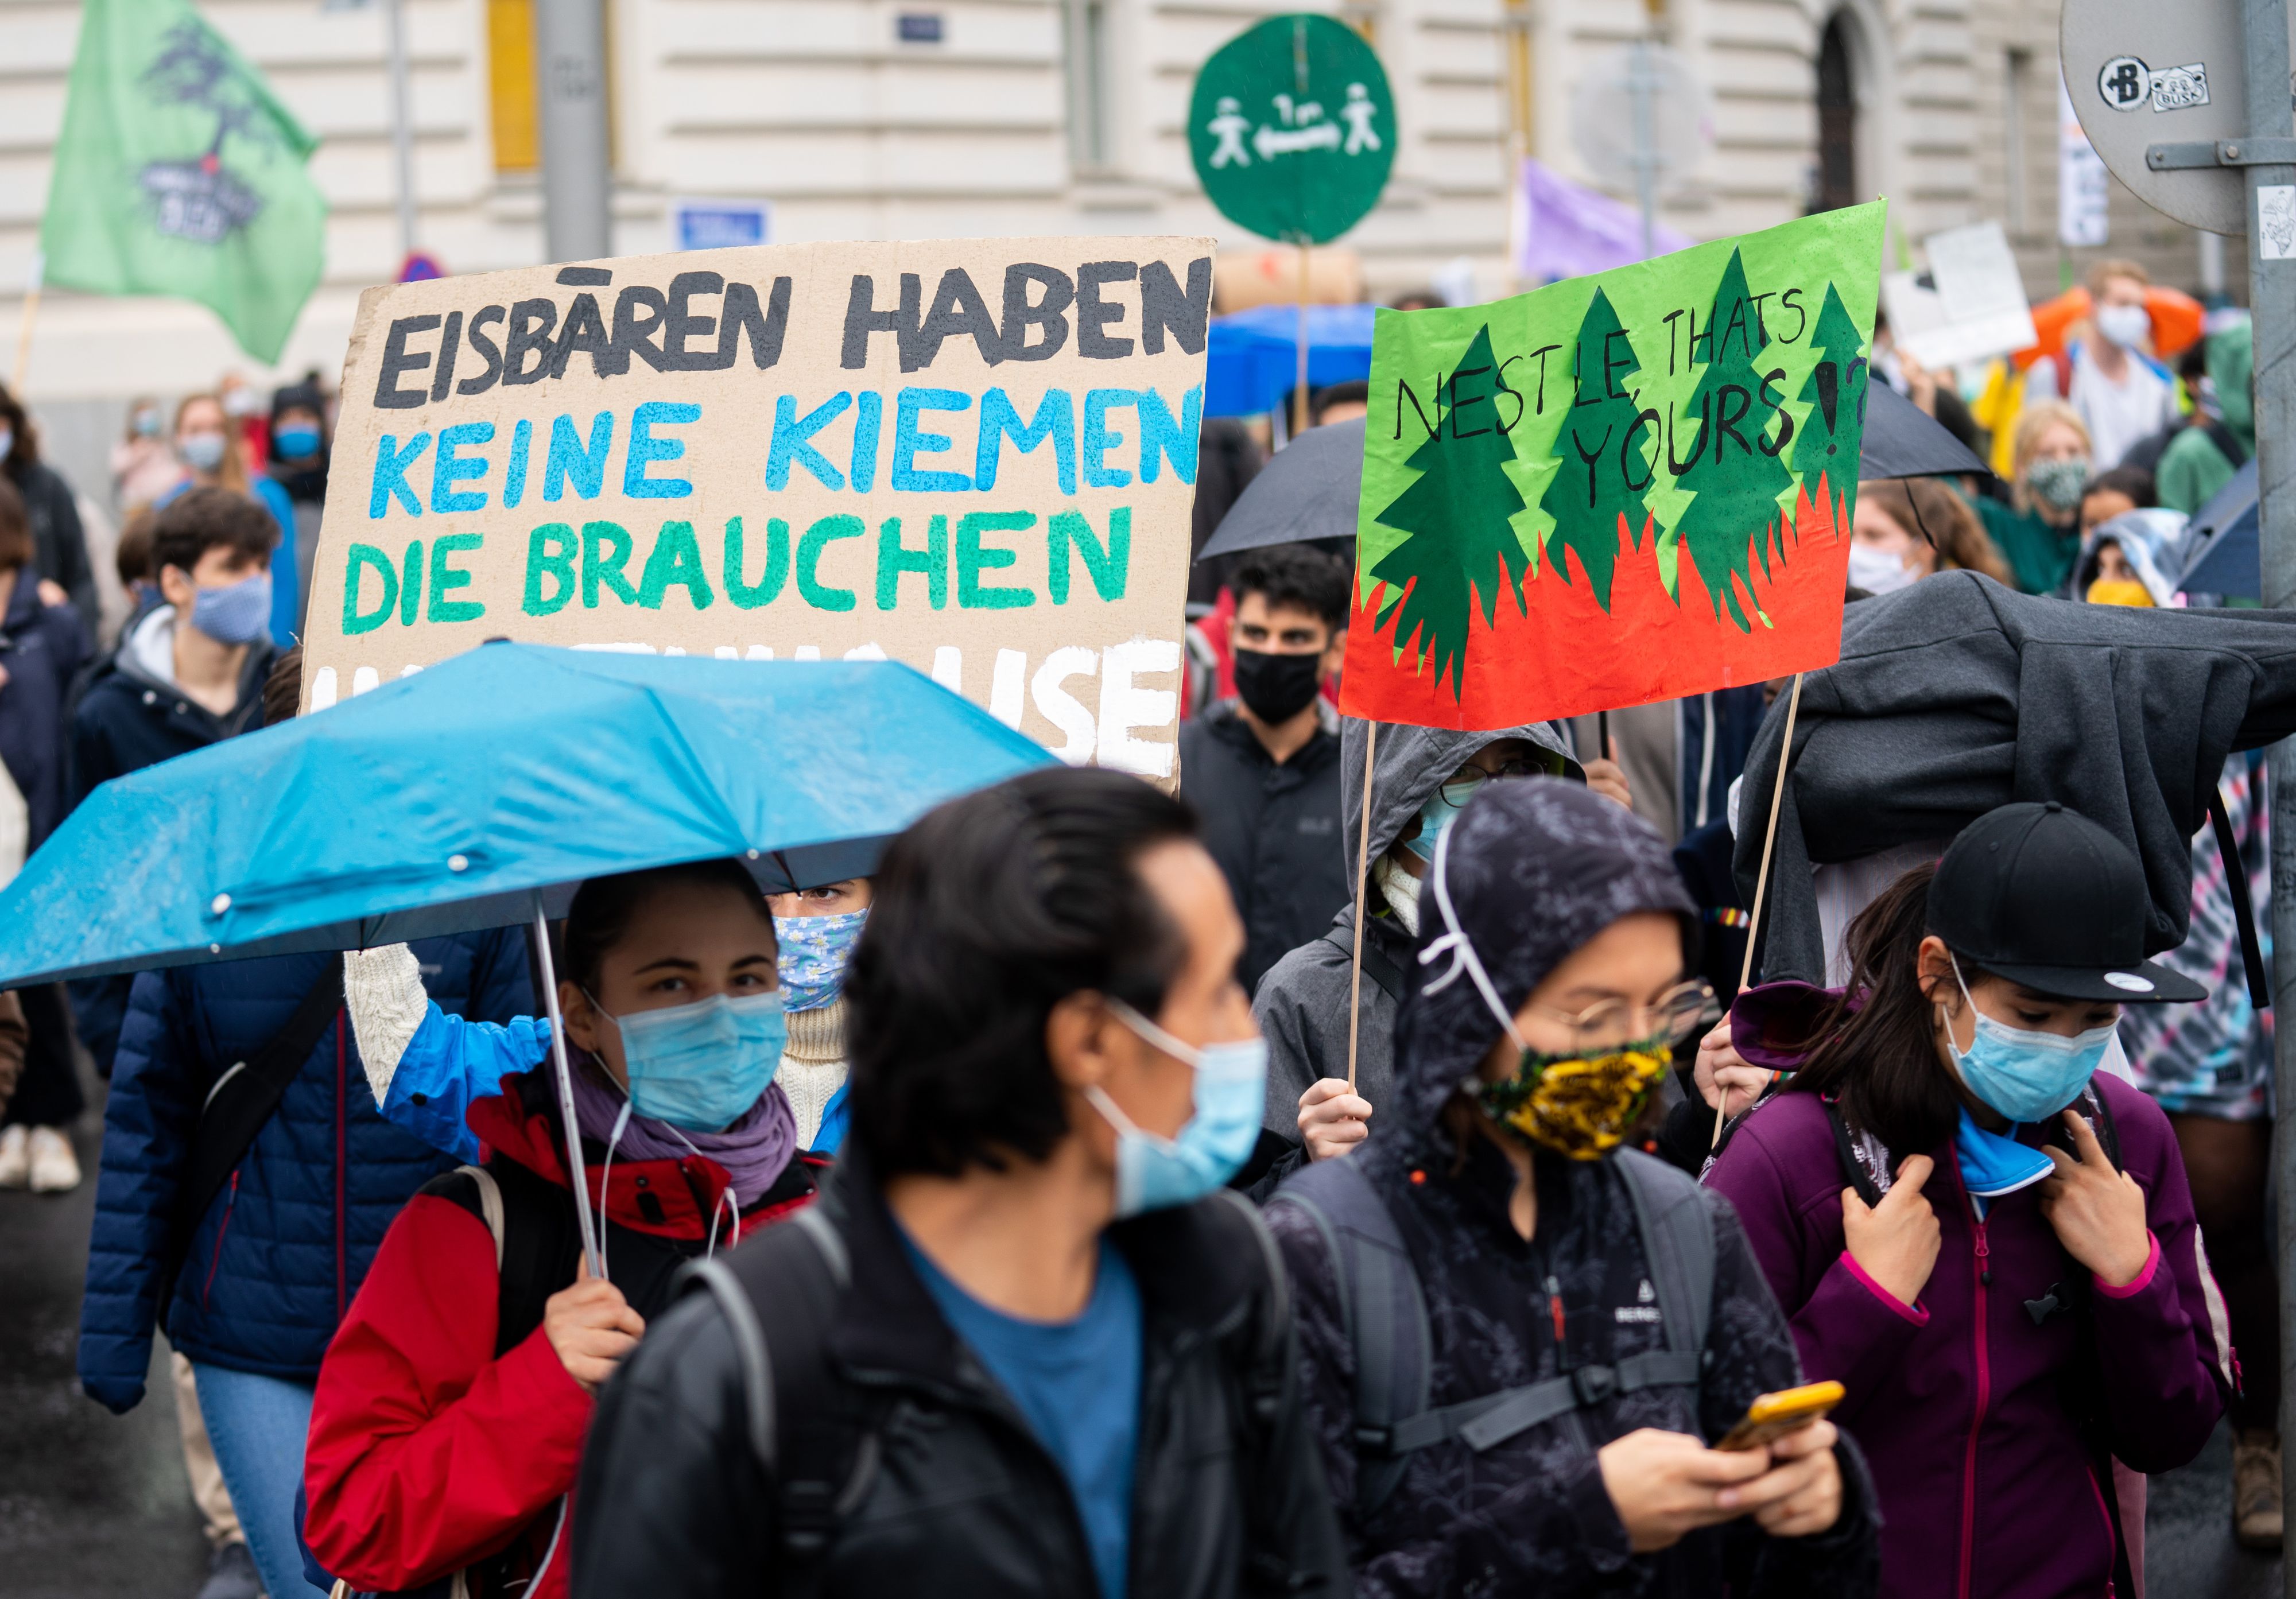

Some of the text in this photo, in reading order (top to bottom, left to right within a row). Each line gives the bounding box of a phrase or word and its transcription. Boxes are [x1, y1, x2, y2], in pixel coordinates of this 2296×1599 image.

[841, 258, 1212, 373] HABEN
[1662, 288, 1806, 377] THATS
[369, 384, 1203, 519] KEINE KIEMEN
[342, 506, 1133, 636] DIE BRAUCHEN
